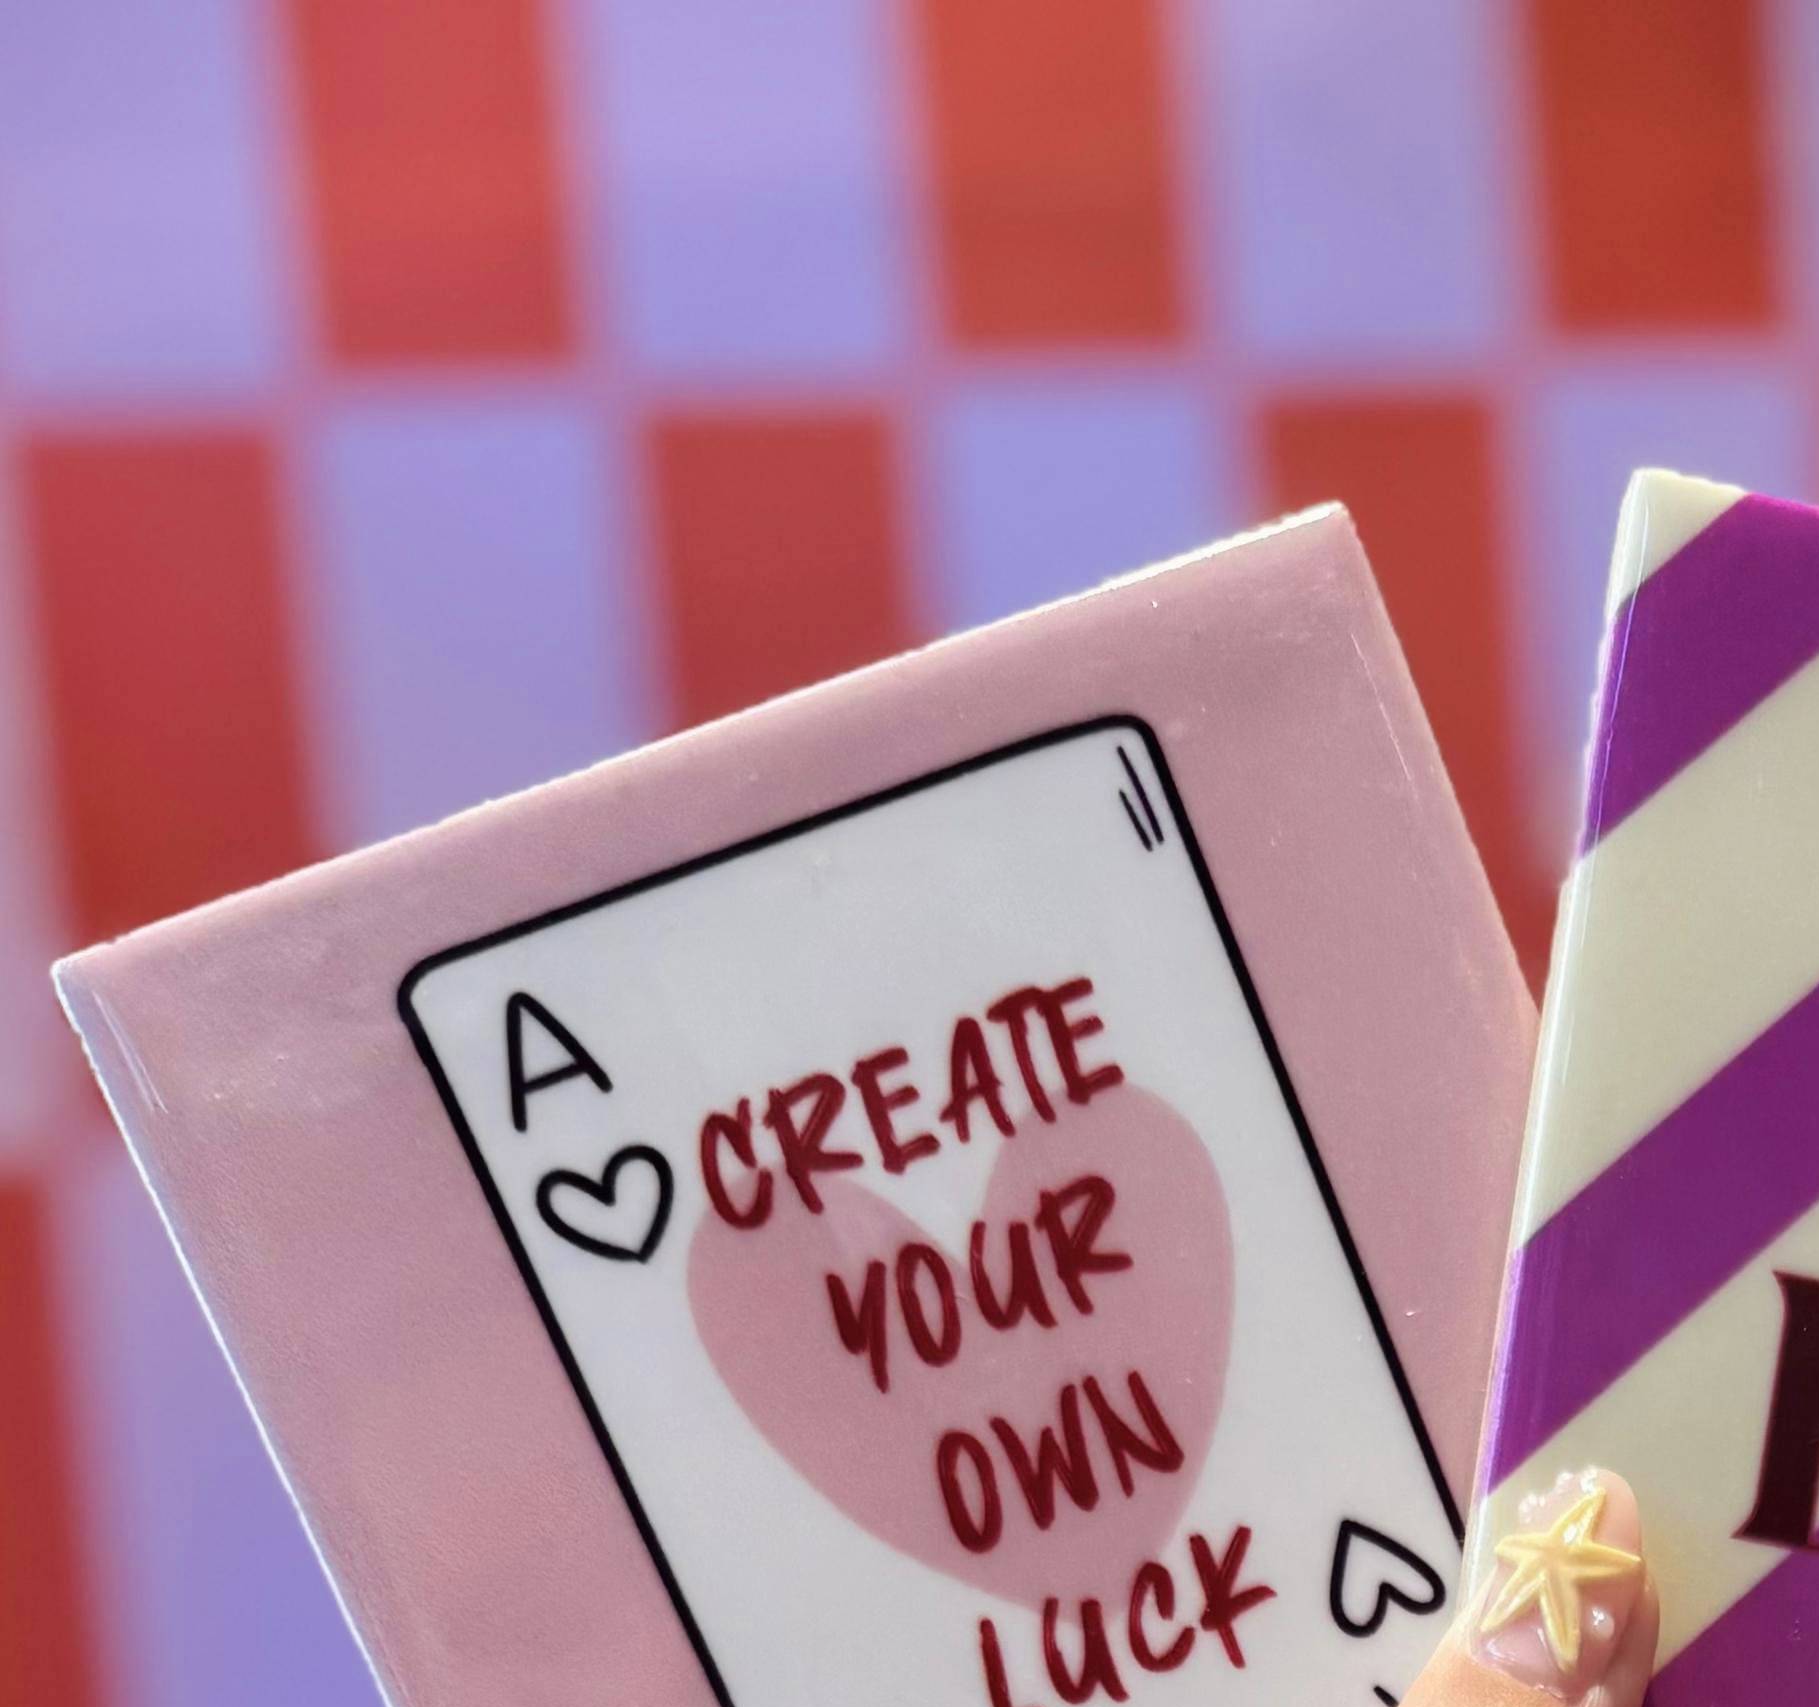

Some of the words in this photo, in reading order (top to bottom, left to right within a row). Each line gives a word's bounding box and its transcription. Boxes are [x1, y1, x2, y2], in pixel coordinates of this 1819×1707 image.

[507, 993, 611, 1132] A
[699, 976, 1125, 1231] CREATE
[826, 1176, 1133, 1394] YOUR
[934, 1371, 1187, 1555] OWN
